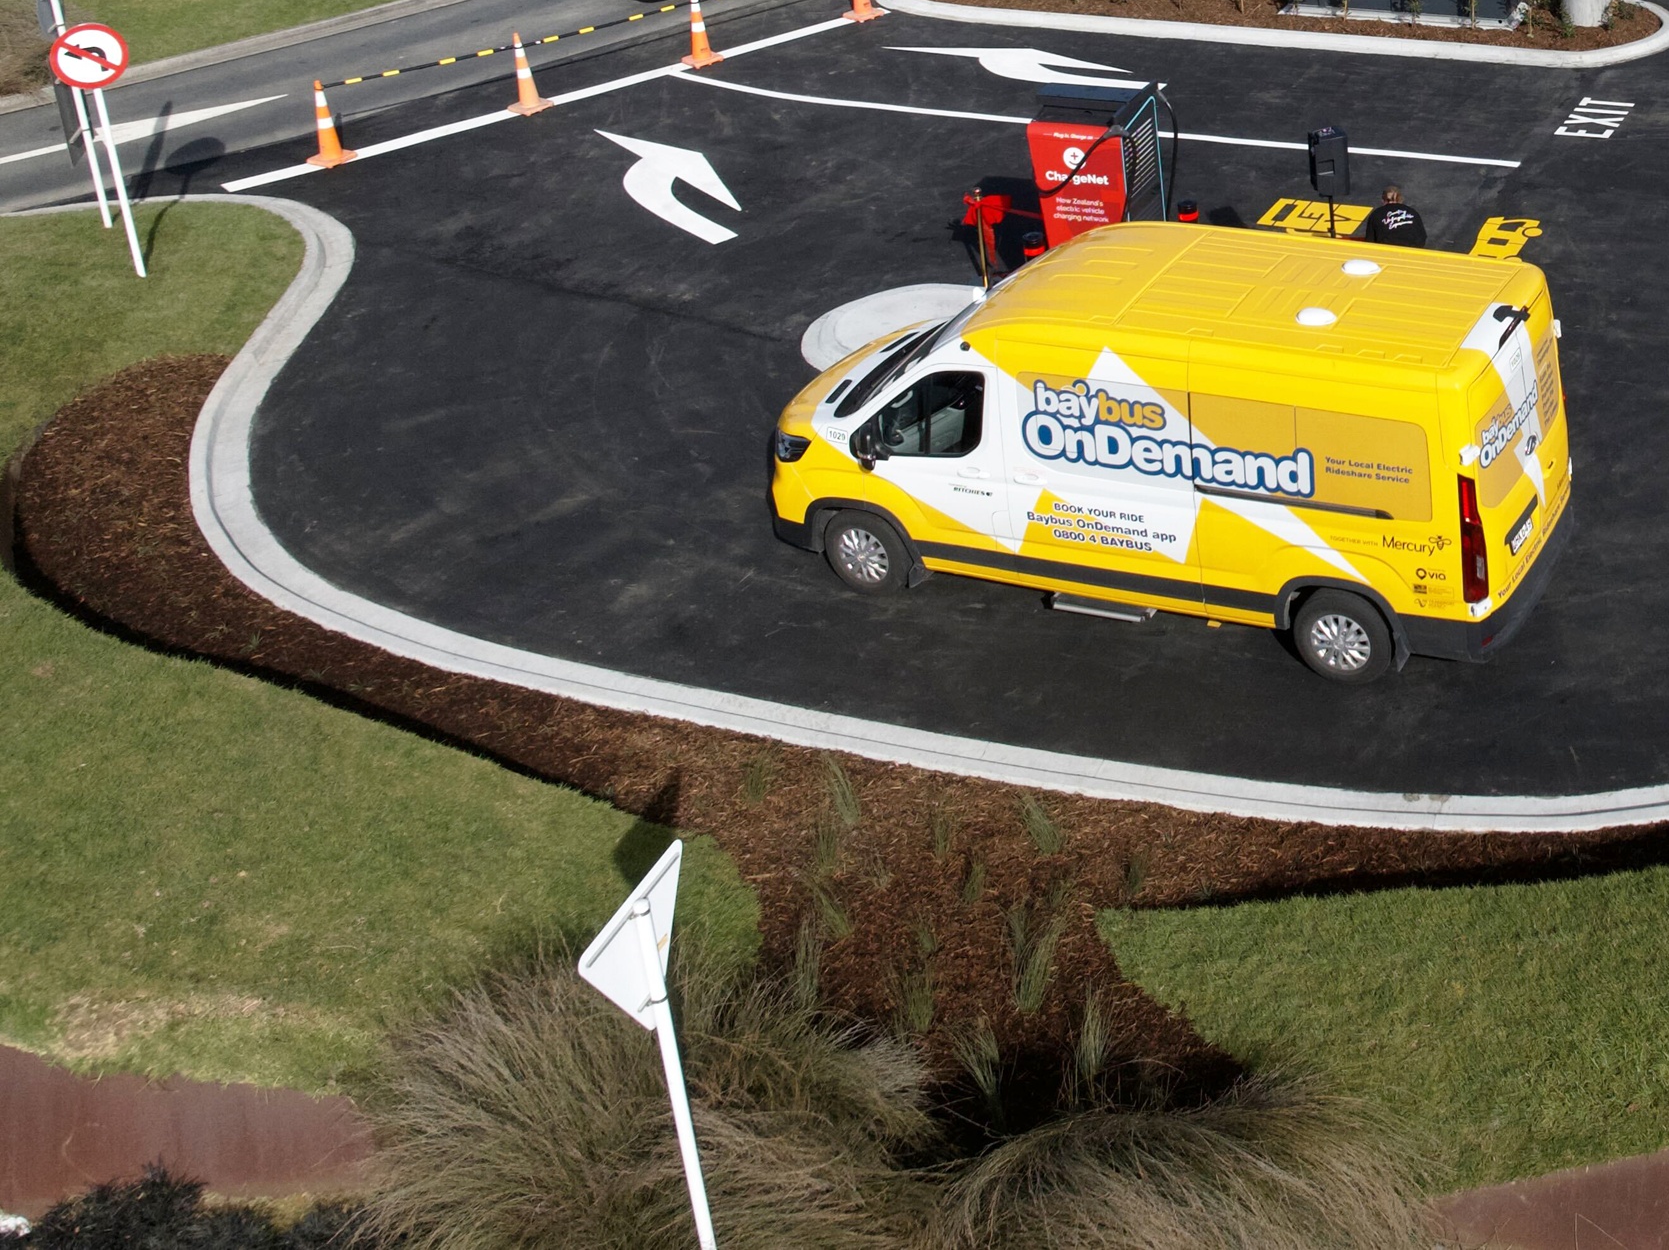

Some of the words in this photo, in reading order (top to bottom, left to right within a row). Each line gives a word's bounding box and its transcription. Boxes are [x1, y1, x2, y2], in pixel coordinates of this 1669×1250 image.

[1554, 97, 1635, 138] EXIT
[1046, 170, 1109, 185] ChageNet
[1056, 205, 1081, 213] electric
[1082, 206, 1104, 214] vehicle
[1073, 198, 1103, 207] Zealand's
[1053, 213, 1082, 222] charging
[1083, 215, 1109, 223] network
[1033, 379, 1166, 430] baybus
[1479, 379, 1538, 469] OnDemand
[1482, 402, 1512, 445] baybus
[829, 431, 846, 441] 1029
[1022, 410, 1315, 498] OnDemand
[1325, 456, 1346, 465] Your
[1349, 460, 1374, 469] Local
[1377, 463, 1413, 474] Electric
[1325, 467, 1372, 479] Rideshare
[1375, 473, 1410, 483] Service
[953, 486, 985, 496] RITCHIES
[1054, 503, 1083, 514] BOOK
[1087, 507, 1116, 519] YOUR
[1119, 511, 1144, 523] RIDE
[1026, 511, 1073, 528] Baybus
[1076, 518, 1148, 538] OnDemand
[1152, 532, 1177, 543] app
[1053, 529, 1085, 541] 0800
[1088, 534, 1097, 544] 4
[1100, 535, 1152, 552] BAYBUS
[1329, 535, 1361, 544] TOGETHER
[1382, 534, 1435, 557] Mercury
[1428, 571, 1446, 580] via
[1498, 581, 1512, 599] Your
[1512, 561, 1526, 583] Local
[1525, 537, 1541, 564] Electric
